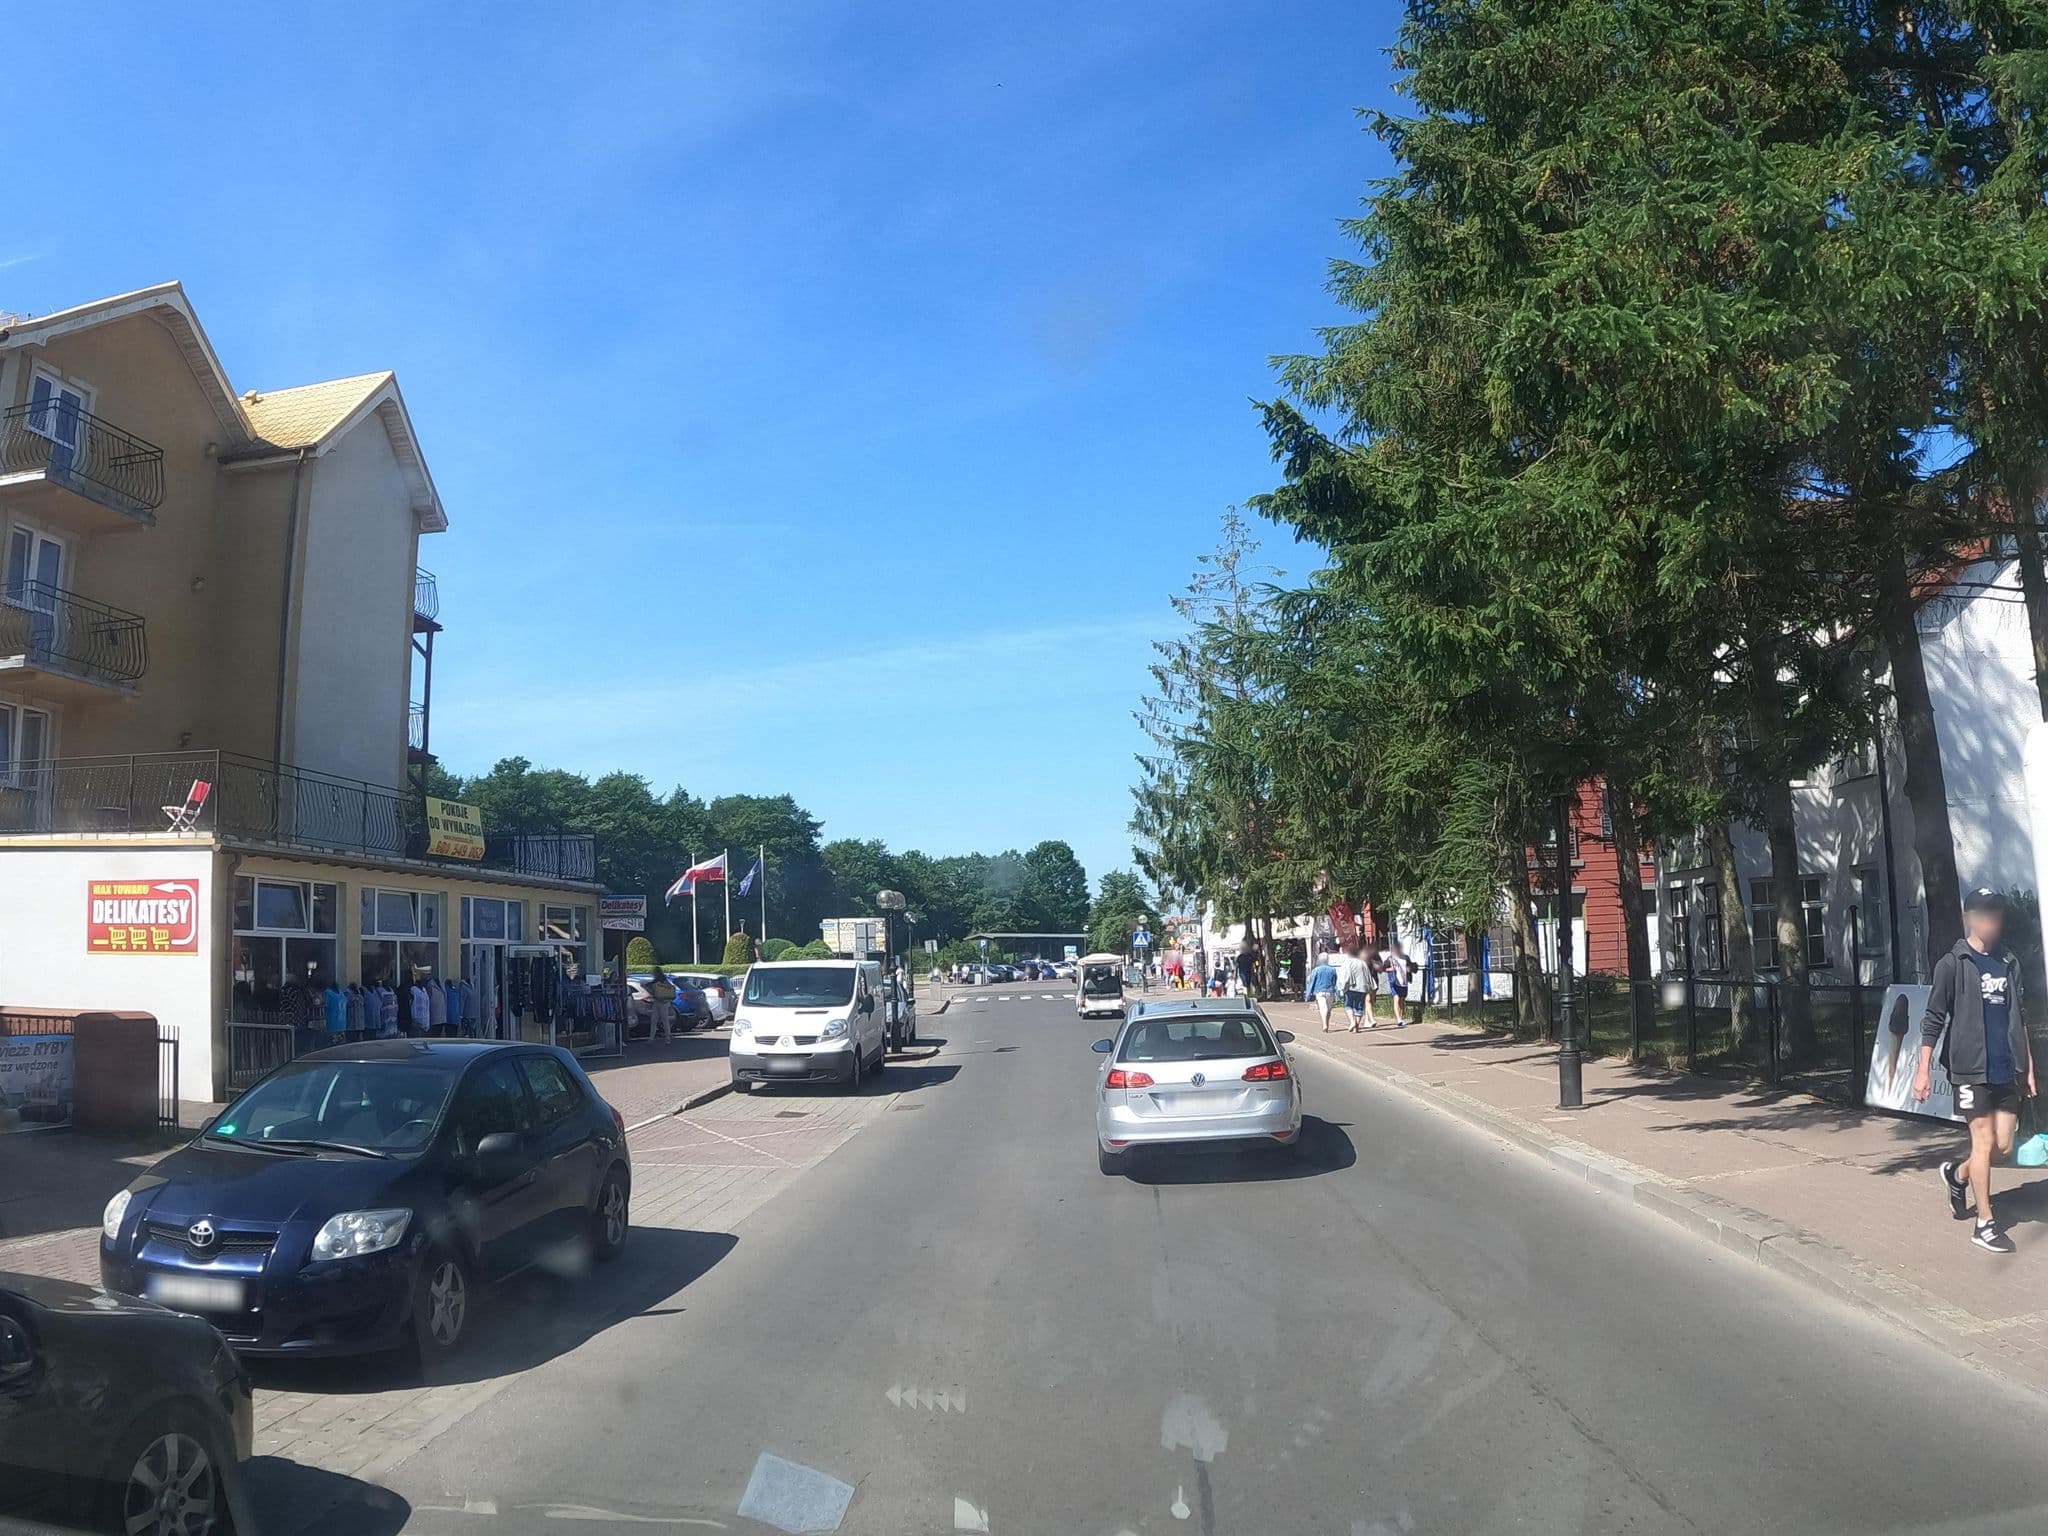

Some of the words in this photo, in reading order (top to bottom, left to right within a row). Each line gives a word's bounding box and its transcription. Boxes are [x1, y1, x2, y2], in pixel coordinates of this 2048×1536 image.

[441, 802, 469, 819] POKOJE
[429, 816, 440, 830] DO
[92, 899, 191, 925] DELIKATESY
[601, 900, 644, 911] Delikatesy
[33, 1041, 68, 1056] RYBY
[15, 1060, 58, 1075] wędzone
